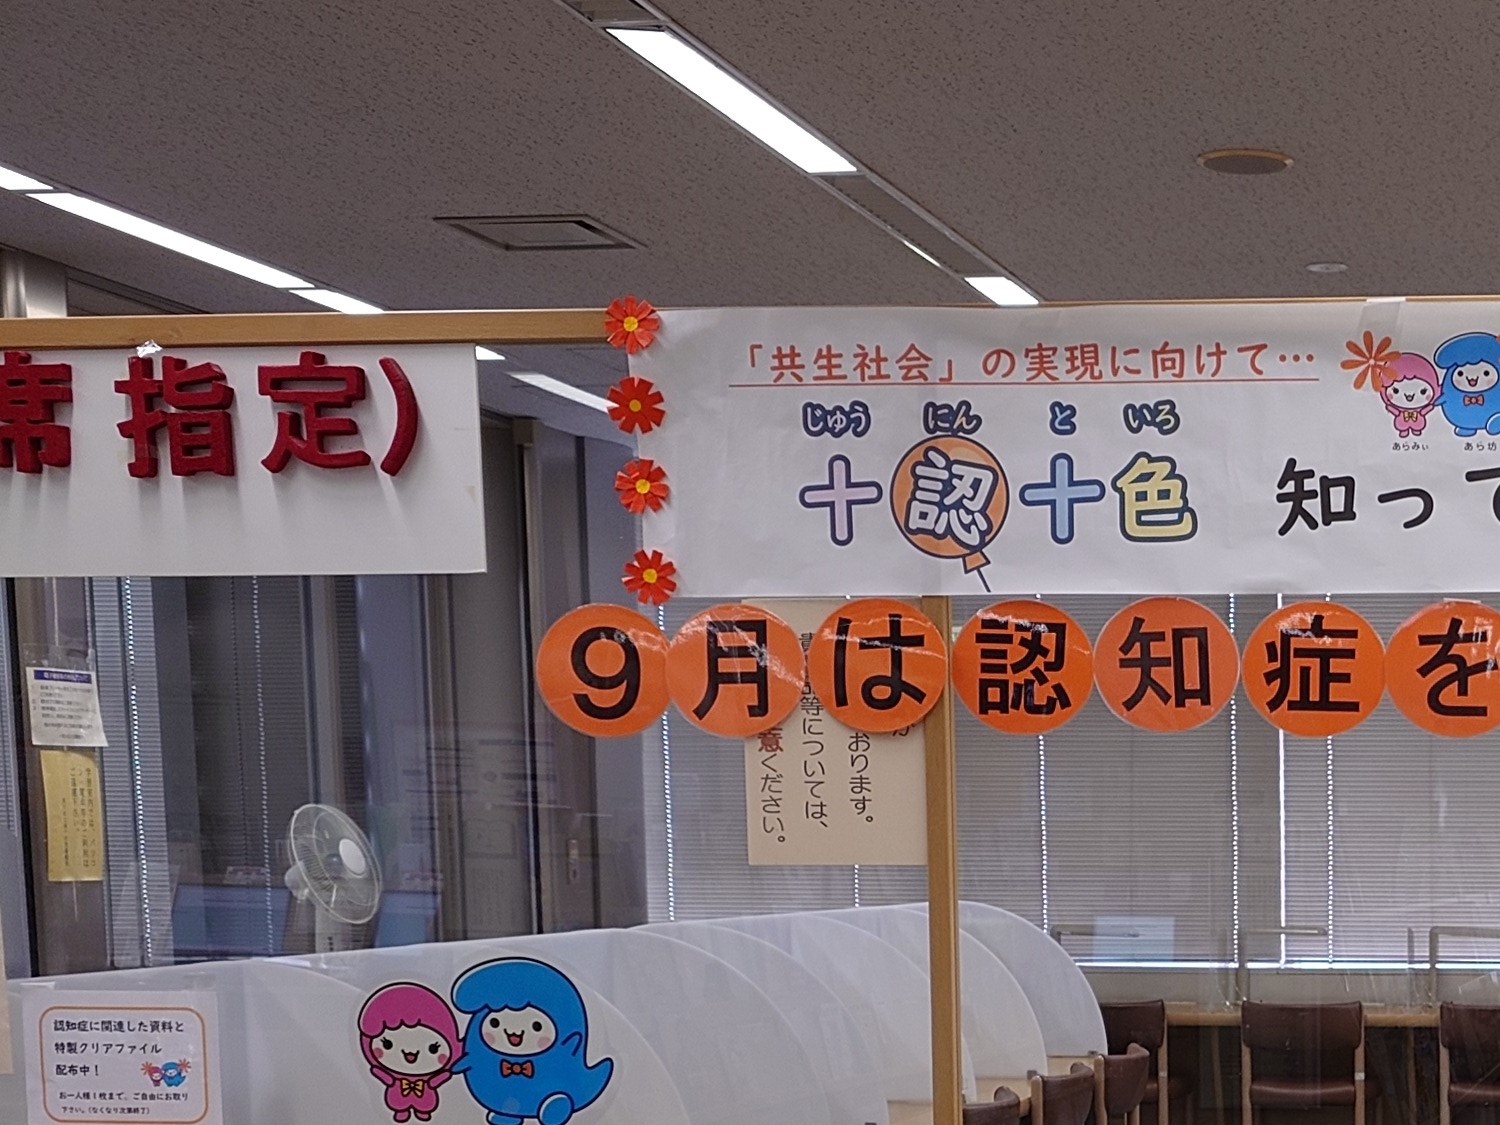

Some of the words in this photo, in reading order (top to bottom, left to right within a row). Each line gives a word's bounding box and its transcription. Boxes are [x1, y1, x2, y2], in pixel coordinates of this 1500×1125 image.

[802, 402, 871, 434] じゅう
[923, 402, 980, 434] にん
[1050, 403, 1076, 434] と
[1123, 402, 1180, 434] いろ
[800, 447, 1197, 547] 十認十色
[53, 1020, 184, 1033] 認知症に関連した資料と
[55, 1042, 162, 1054] 特製クリアファイル
